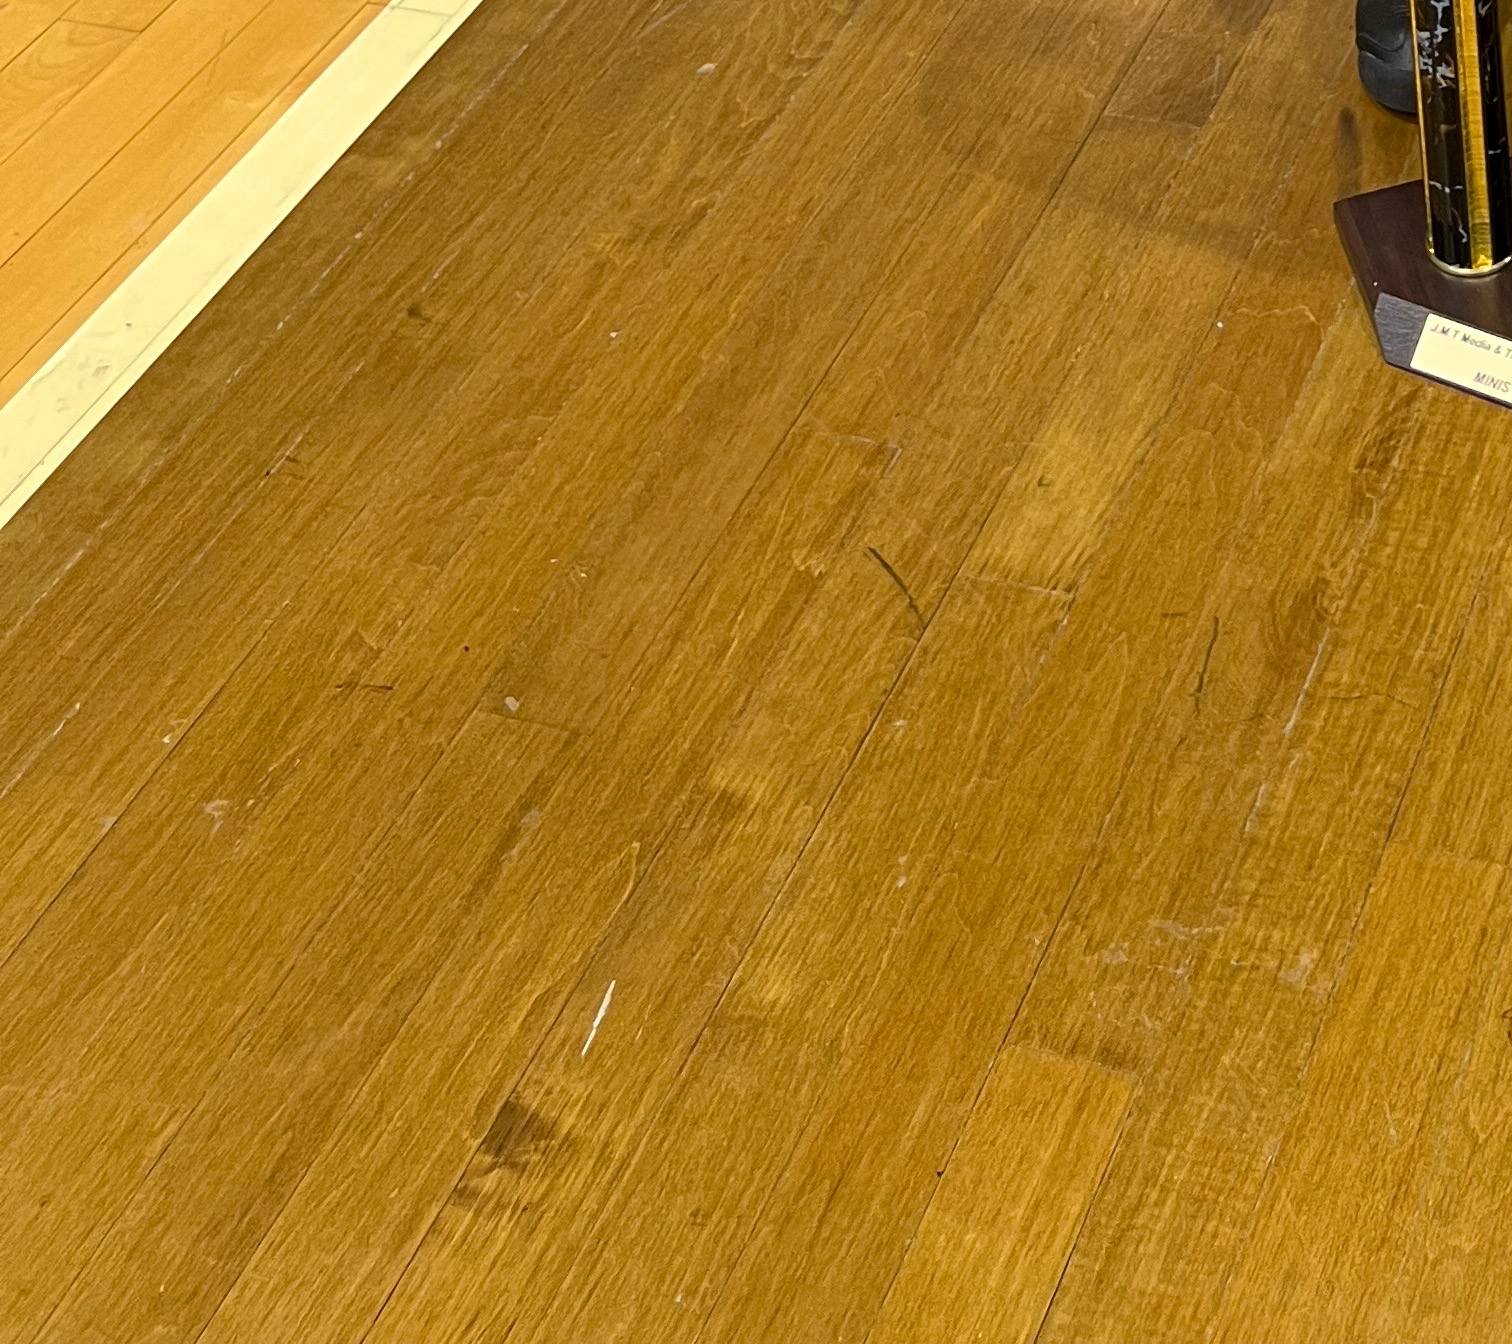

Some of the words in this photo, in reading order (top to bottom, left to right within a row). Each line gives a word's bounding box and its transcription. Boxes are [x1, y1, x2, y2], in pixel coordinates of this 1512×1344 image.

[1461, 332, 1491, 351] Media
[1493, 345, 1502, 355] &
[1473, 372, 1512, 393] MINIS
